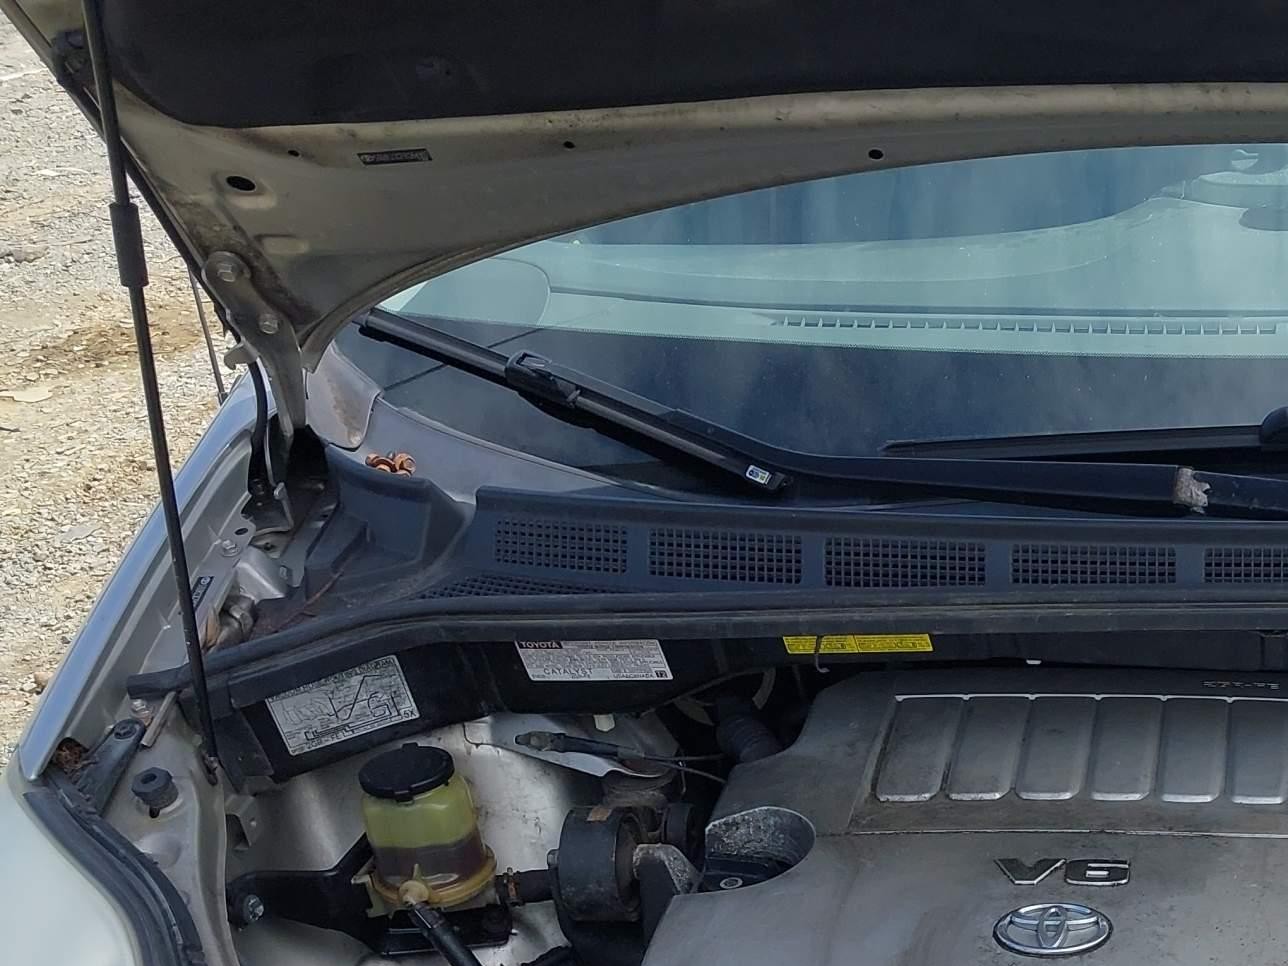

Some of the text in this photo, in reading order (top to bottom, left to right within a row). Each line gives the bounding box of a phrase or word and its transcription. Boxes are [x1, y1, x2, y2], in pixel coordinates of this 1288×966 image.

[520, 641, 560, 649] TOYOTA
[543, 667, 593, 677] CATALYST
[403, 708, 417, 719] 5X
[993, 857, 1131, 886] V6
